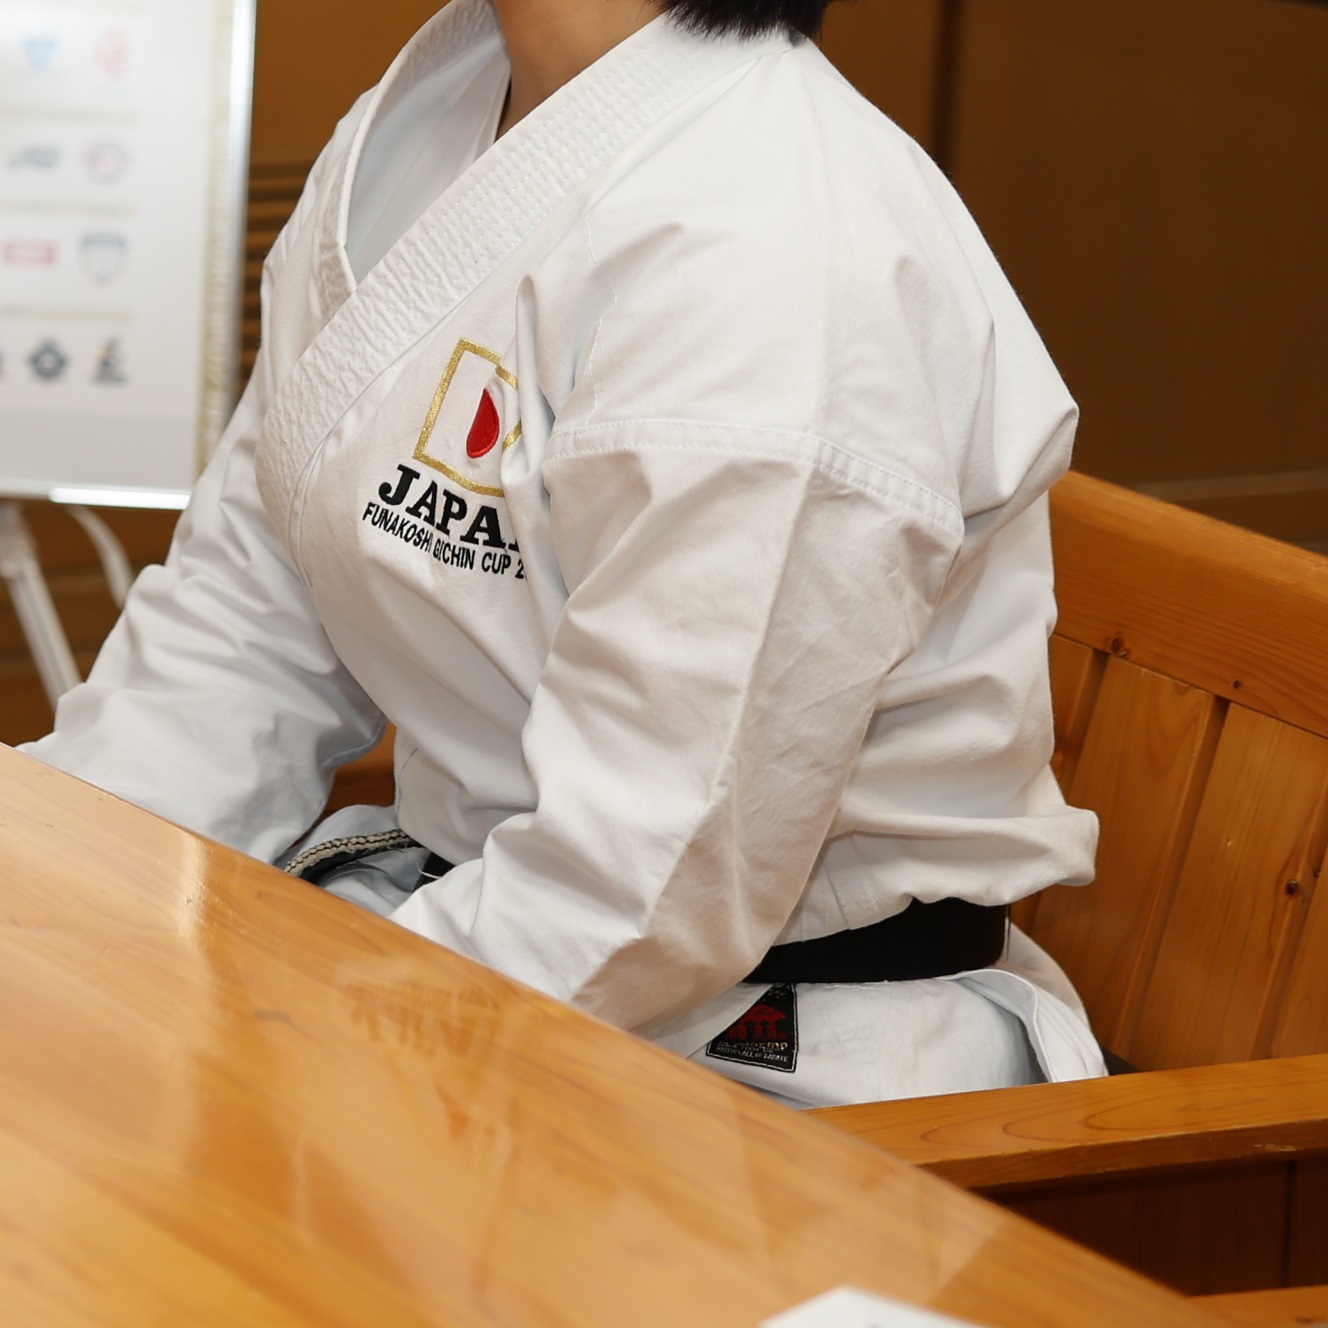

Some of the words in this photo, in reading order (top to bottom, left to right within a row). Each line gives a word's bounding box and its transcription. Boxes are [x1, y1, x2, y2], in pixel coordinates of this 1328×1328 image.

[362, 501, 435, 553] FUNAKOSHI
[433, 538, 476, 571] GICHIN
[481, 552, 512, 576] CUP
[515, 558, 529, 581] 2
[378, 464, 521, 553] JAPA
